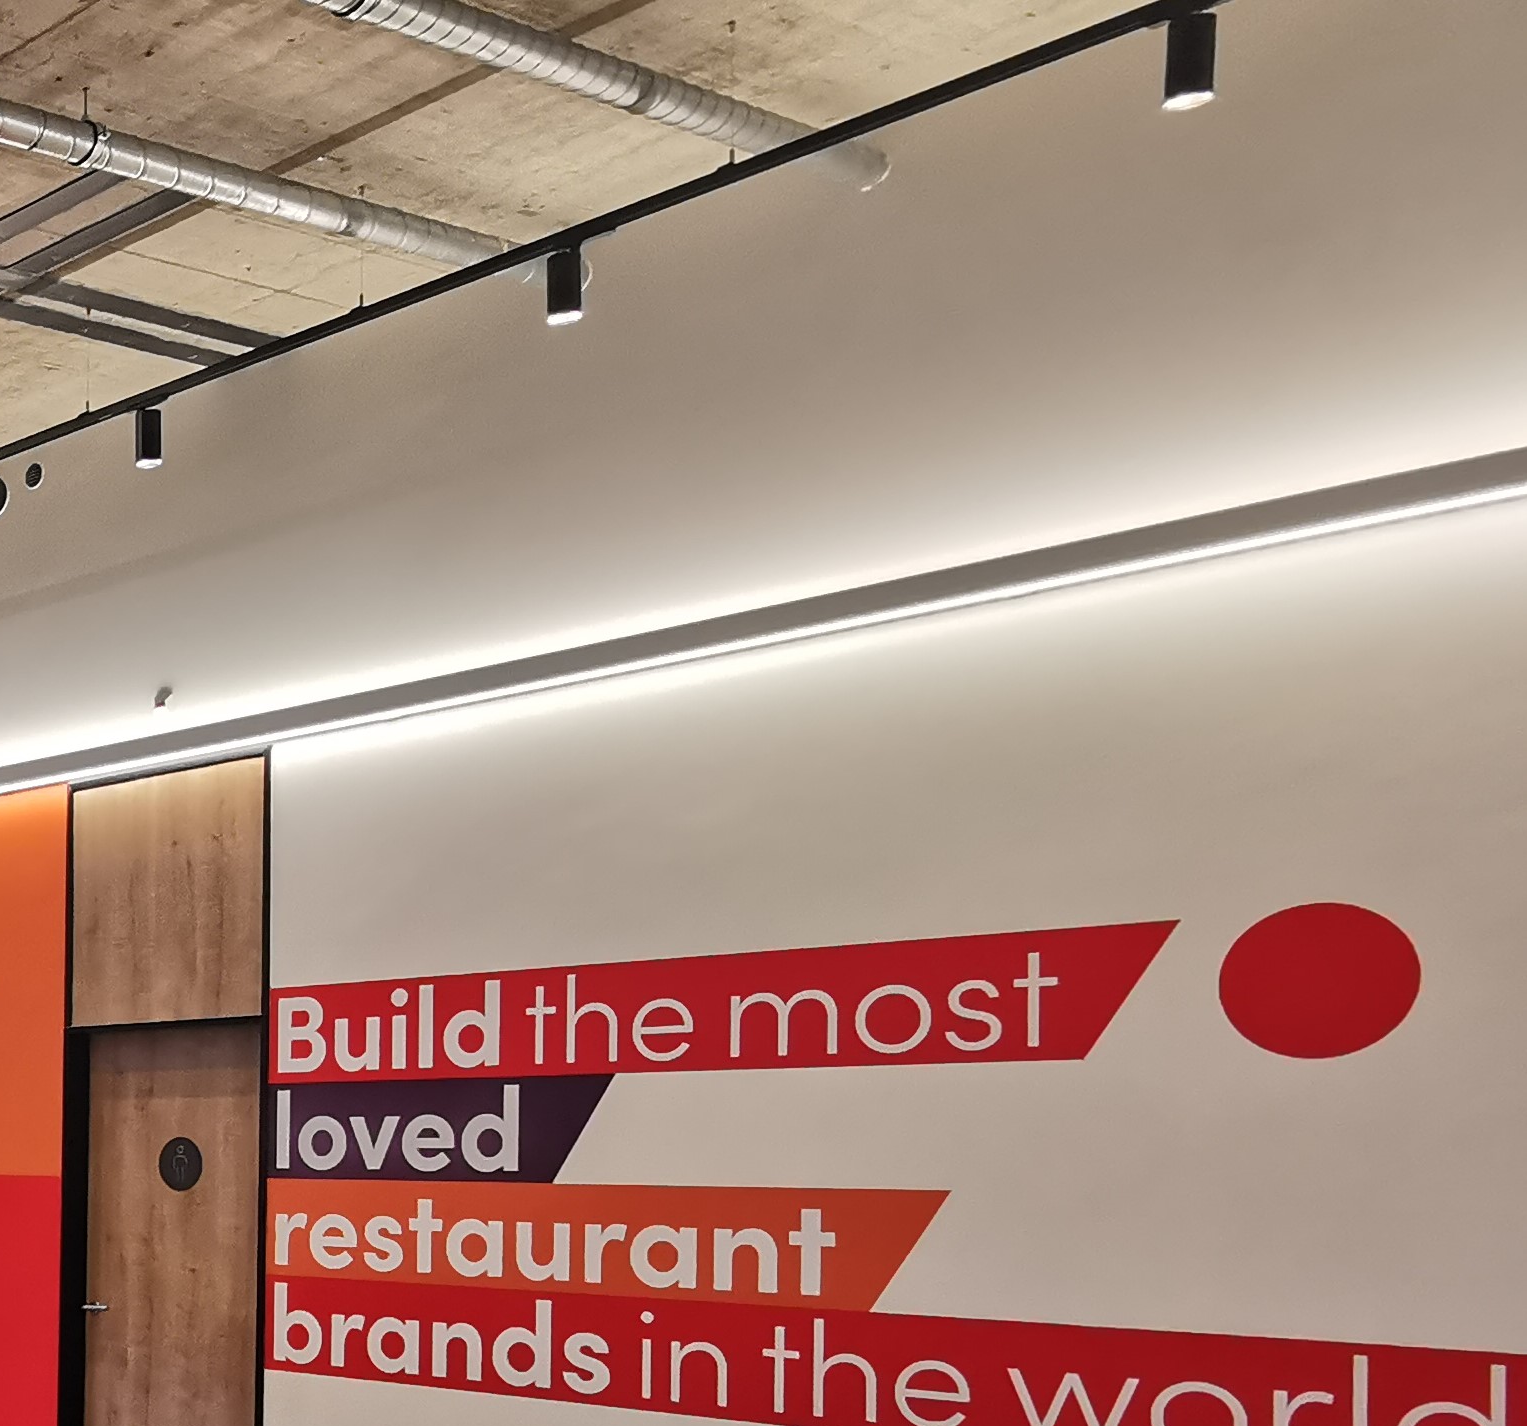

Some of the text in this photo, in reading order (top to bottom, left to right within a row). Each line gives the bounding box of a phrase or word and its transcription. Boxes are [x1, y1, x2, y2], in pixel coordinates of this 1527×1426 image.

[275, 951, 1060, 1075] Build the most
[275, 1083, 521, 1173] loved
[274, 1198, 837, 1297] restaurant
[273, 1281, 613, 1395] brands
[637, 1312, 729, 1408] in
